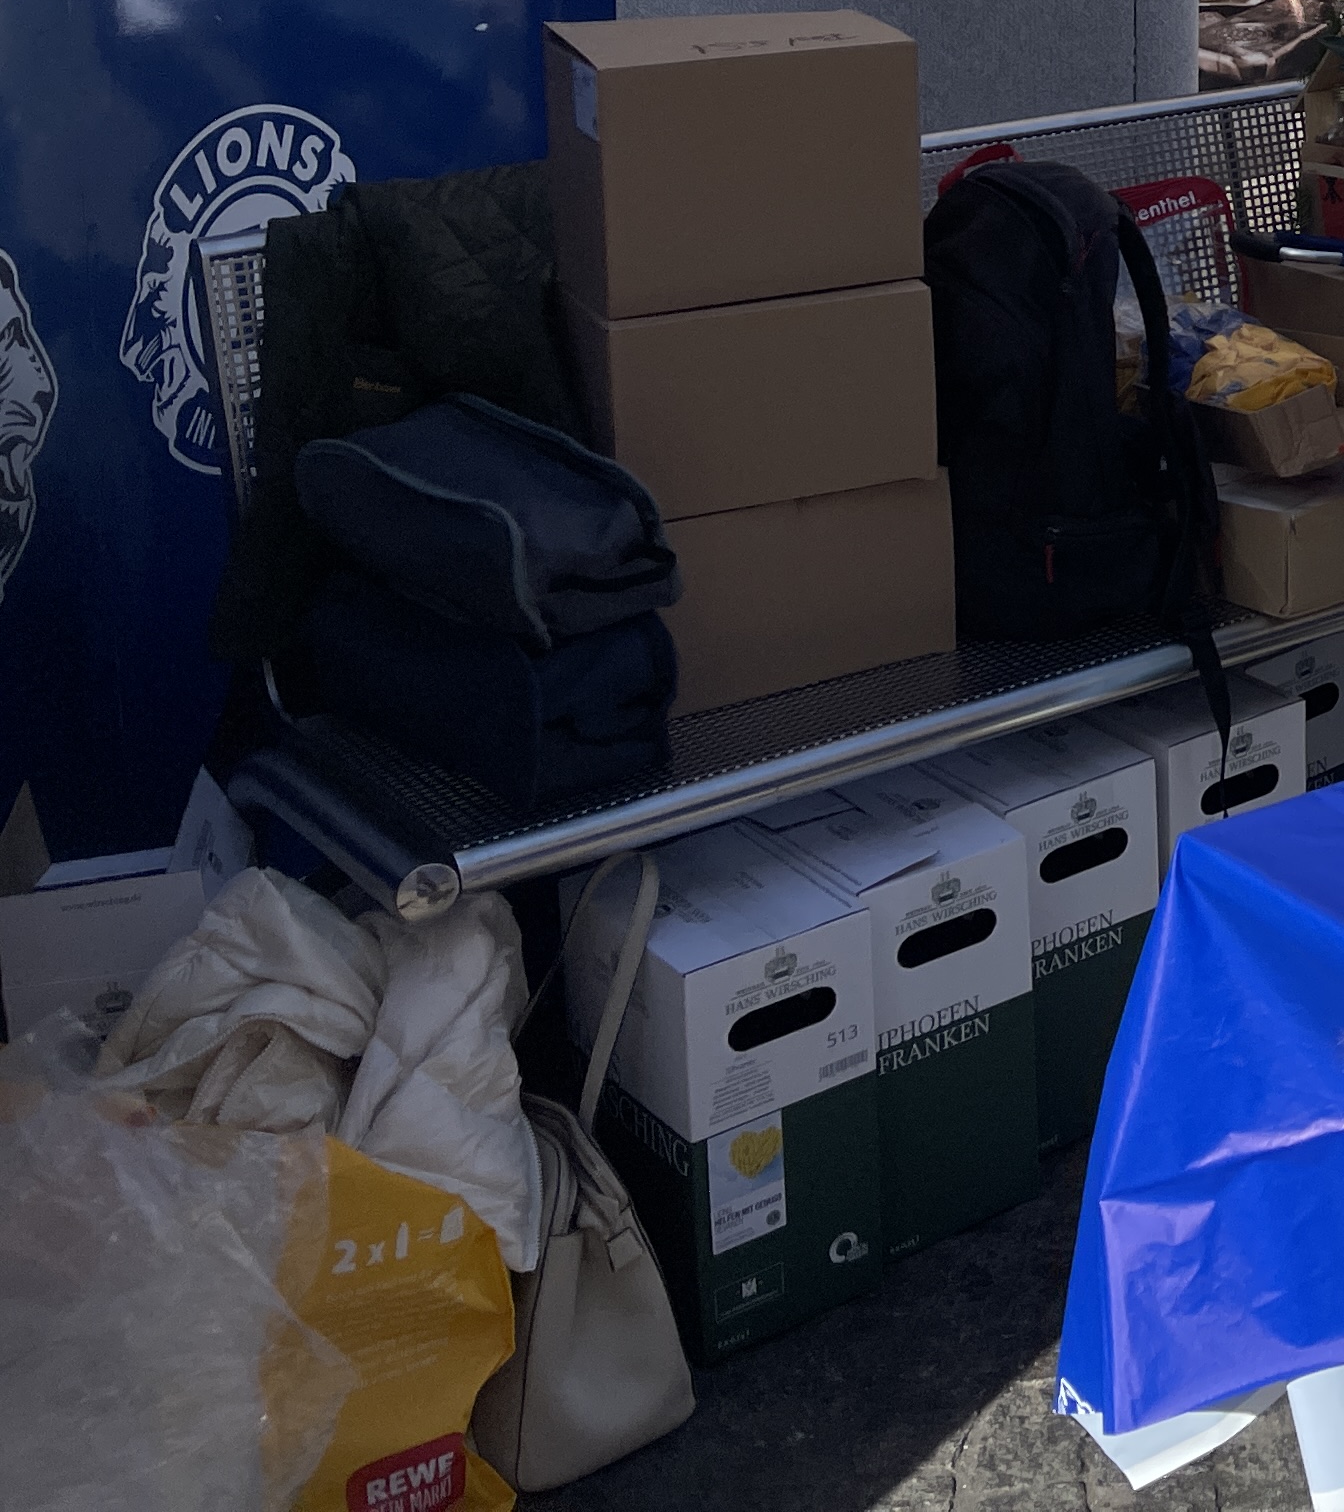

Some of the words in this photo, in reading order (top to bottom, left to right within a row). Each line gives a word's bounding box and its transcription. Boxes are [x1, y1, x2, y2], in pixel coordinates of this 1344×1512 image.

[169, 120, 326, 222] LIONS
[1138, 191, 1197, 221] enthel
[1200, 766, 1222, 783] HAN
[1038, 834, 1067, 853] HANS
[1070, 810, 1129, 840] WIRSCHING
[895, 915, 928, 936] HANS
[932, 890, 998, 922] WIRSCHING
[1031, 909, 1114, 957] PHOFEN
[1034, 927, 1124, 980] RANKEN
[725, 991, 760, 1016] HANS
[765, 964, 837, 1001] WIRSCHING
[826, 1024, 858, 1049] 513
[877, 995, 980, 1051] IPHOFEN
[879, 1013, 990, 1077] FRANKEN
[601, 1085, 690, 1176] SCHING
[332, 1239, 357, 1276] 2
[366, 1451, 454, 1506] REWE
